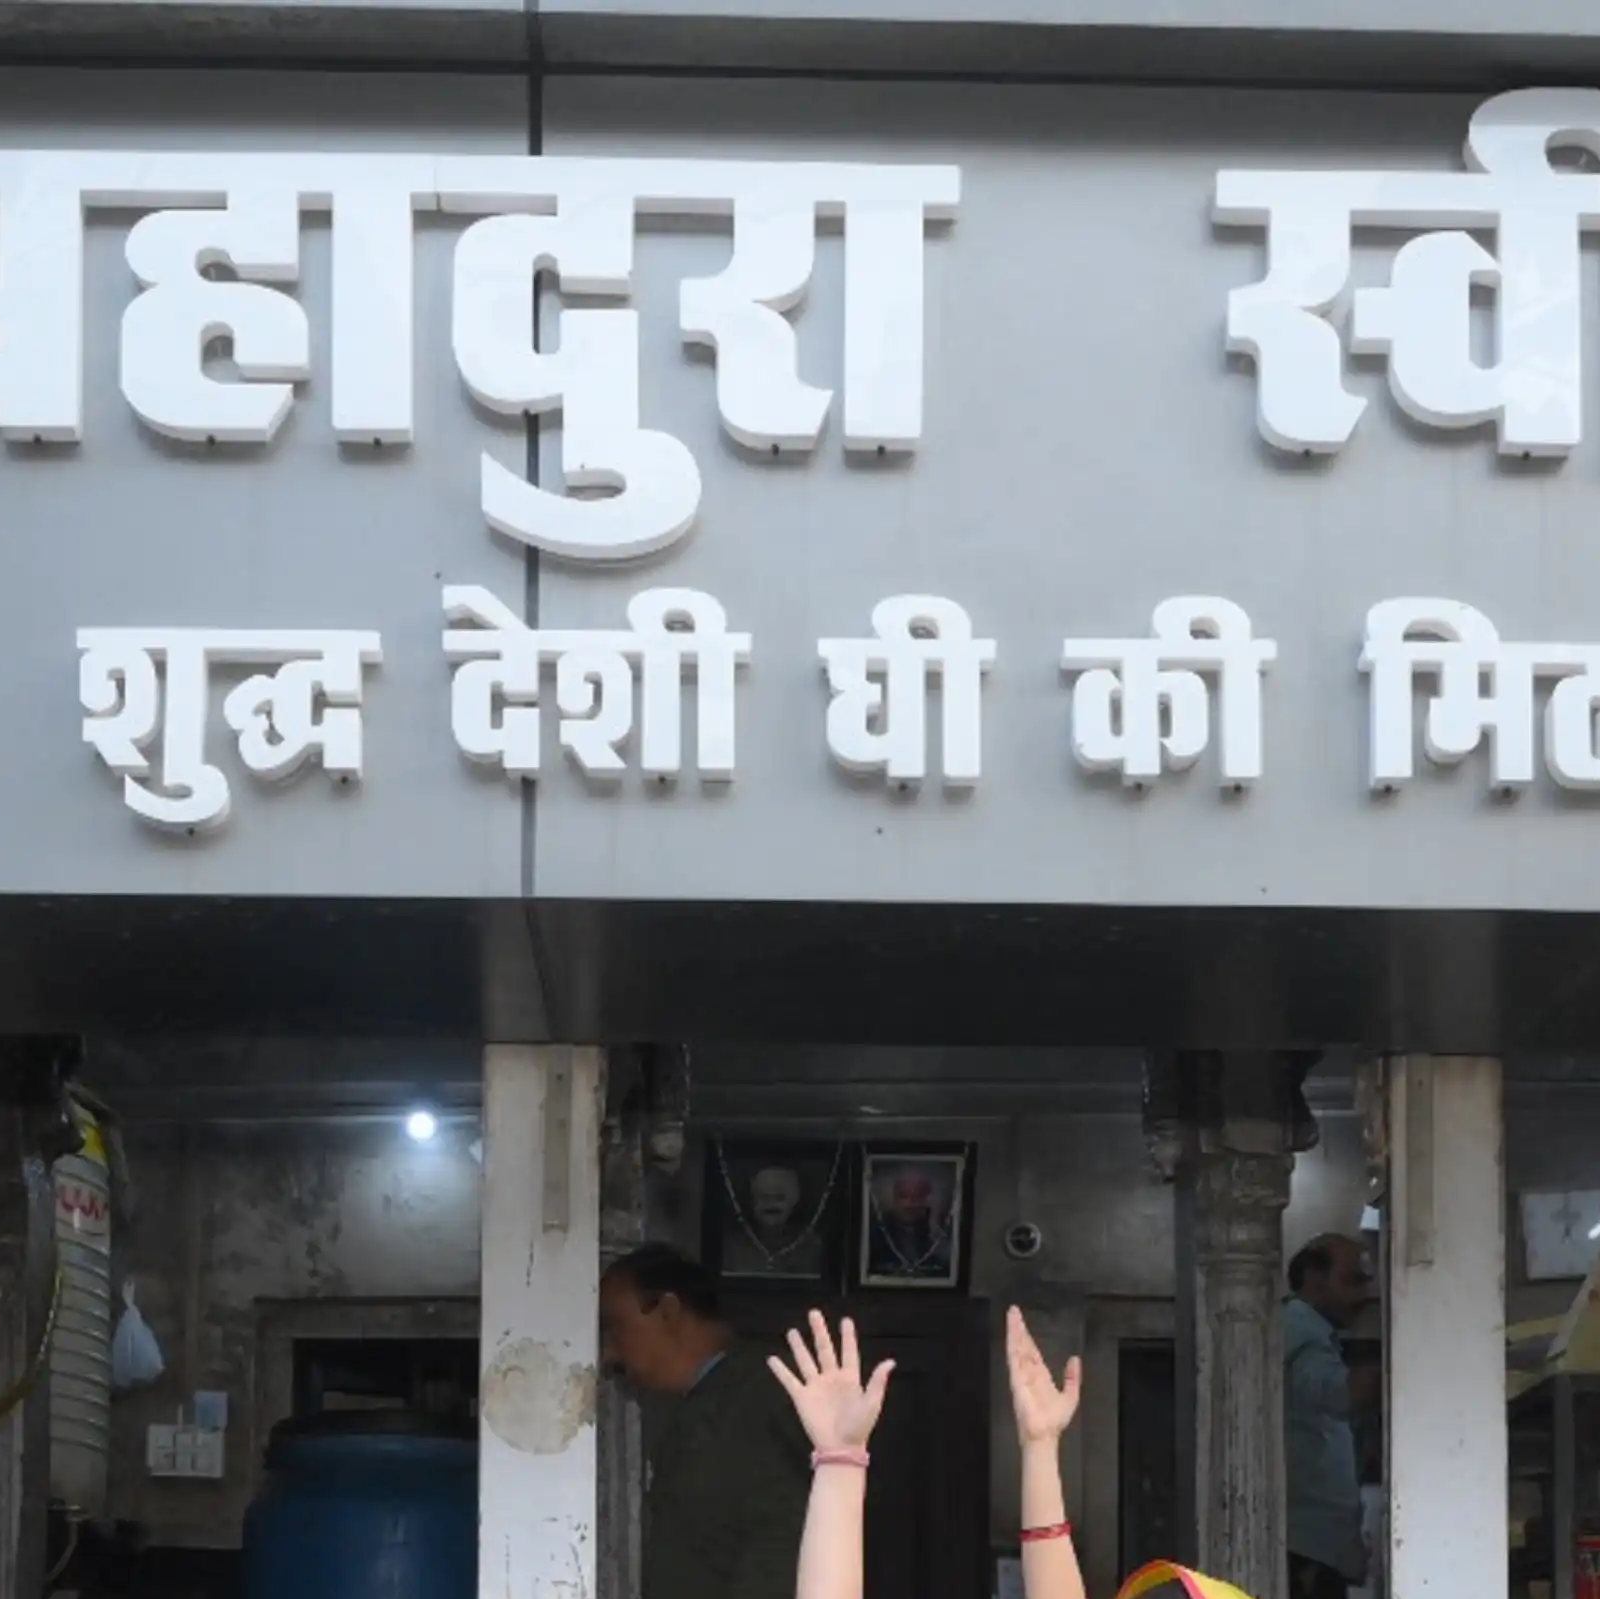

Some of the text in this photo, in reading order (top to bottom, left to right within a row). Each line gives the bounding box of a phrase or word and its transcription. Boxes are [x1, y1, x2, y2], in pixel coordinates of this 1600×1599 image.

[76, 626, 384, 828] शुद्ध
[442, 585, 753, 784] देशी
[818, 594, 997, 789] घी
[1061, 595, 1278, 790] की
